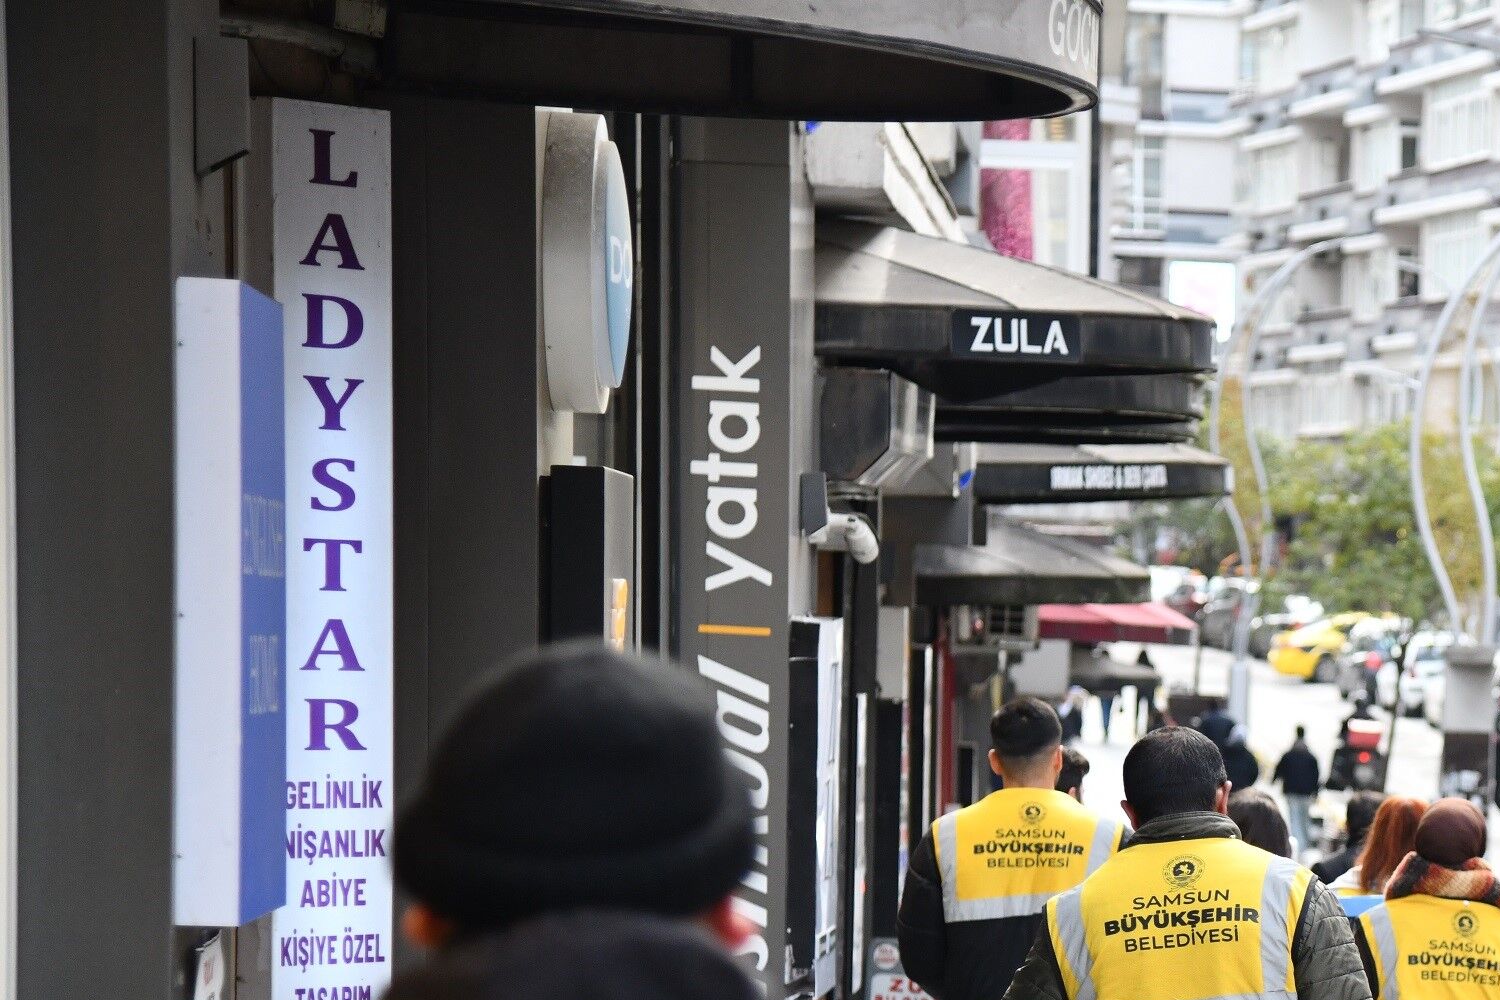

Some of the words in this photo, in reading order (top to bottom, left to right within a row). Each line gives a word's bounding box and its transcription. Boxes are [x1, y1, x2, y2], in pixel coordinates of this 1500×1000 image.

[970, 316, 1069, 355] ZULA
[299, 128, 367, 751] LADYSTAR
[690, 345, 772, 592] yatak
[286, 773, 382, 809] GELİNLİK
[286, 823, 385, 865] NİŞANLIK
[973, 840, 1084, 856] BÜYÜKŞEHİR
[995, 828, 1066, 839] SAMSUN
[987, 856, 1069, 868] BELEDİYESİ
[300, 872, 366, 907] ABİYE
[1132, 889, 1230, 910] SAMSUN
[1104, 904, 1259, 936] BÜYÜKŞEHİR
[280, 928, 337, 973] KİŞİYE
[342, 926, 385, 965] ÖZEL
[1124, 925, 1239, 953] BELEDİYESİ
[1428, 939, 1496, 956] SAMSUN
[1421, 969, 1500, 986] BELEDİYESİ
